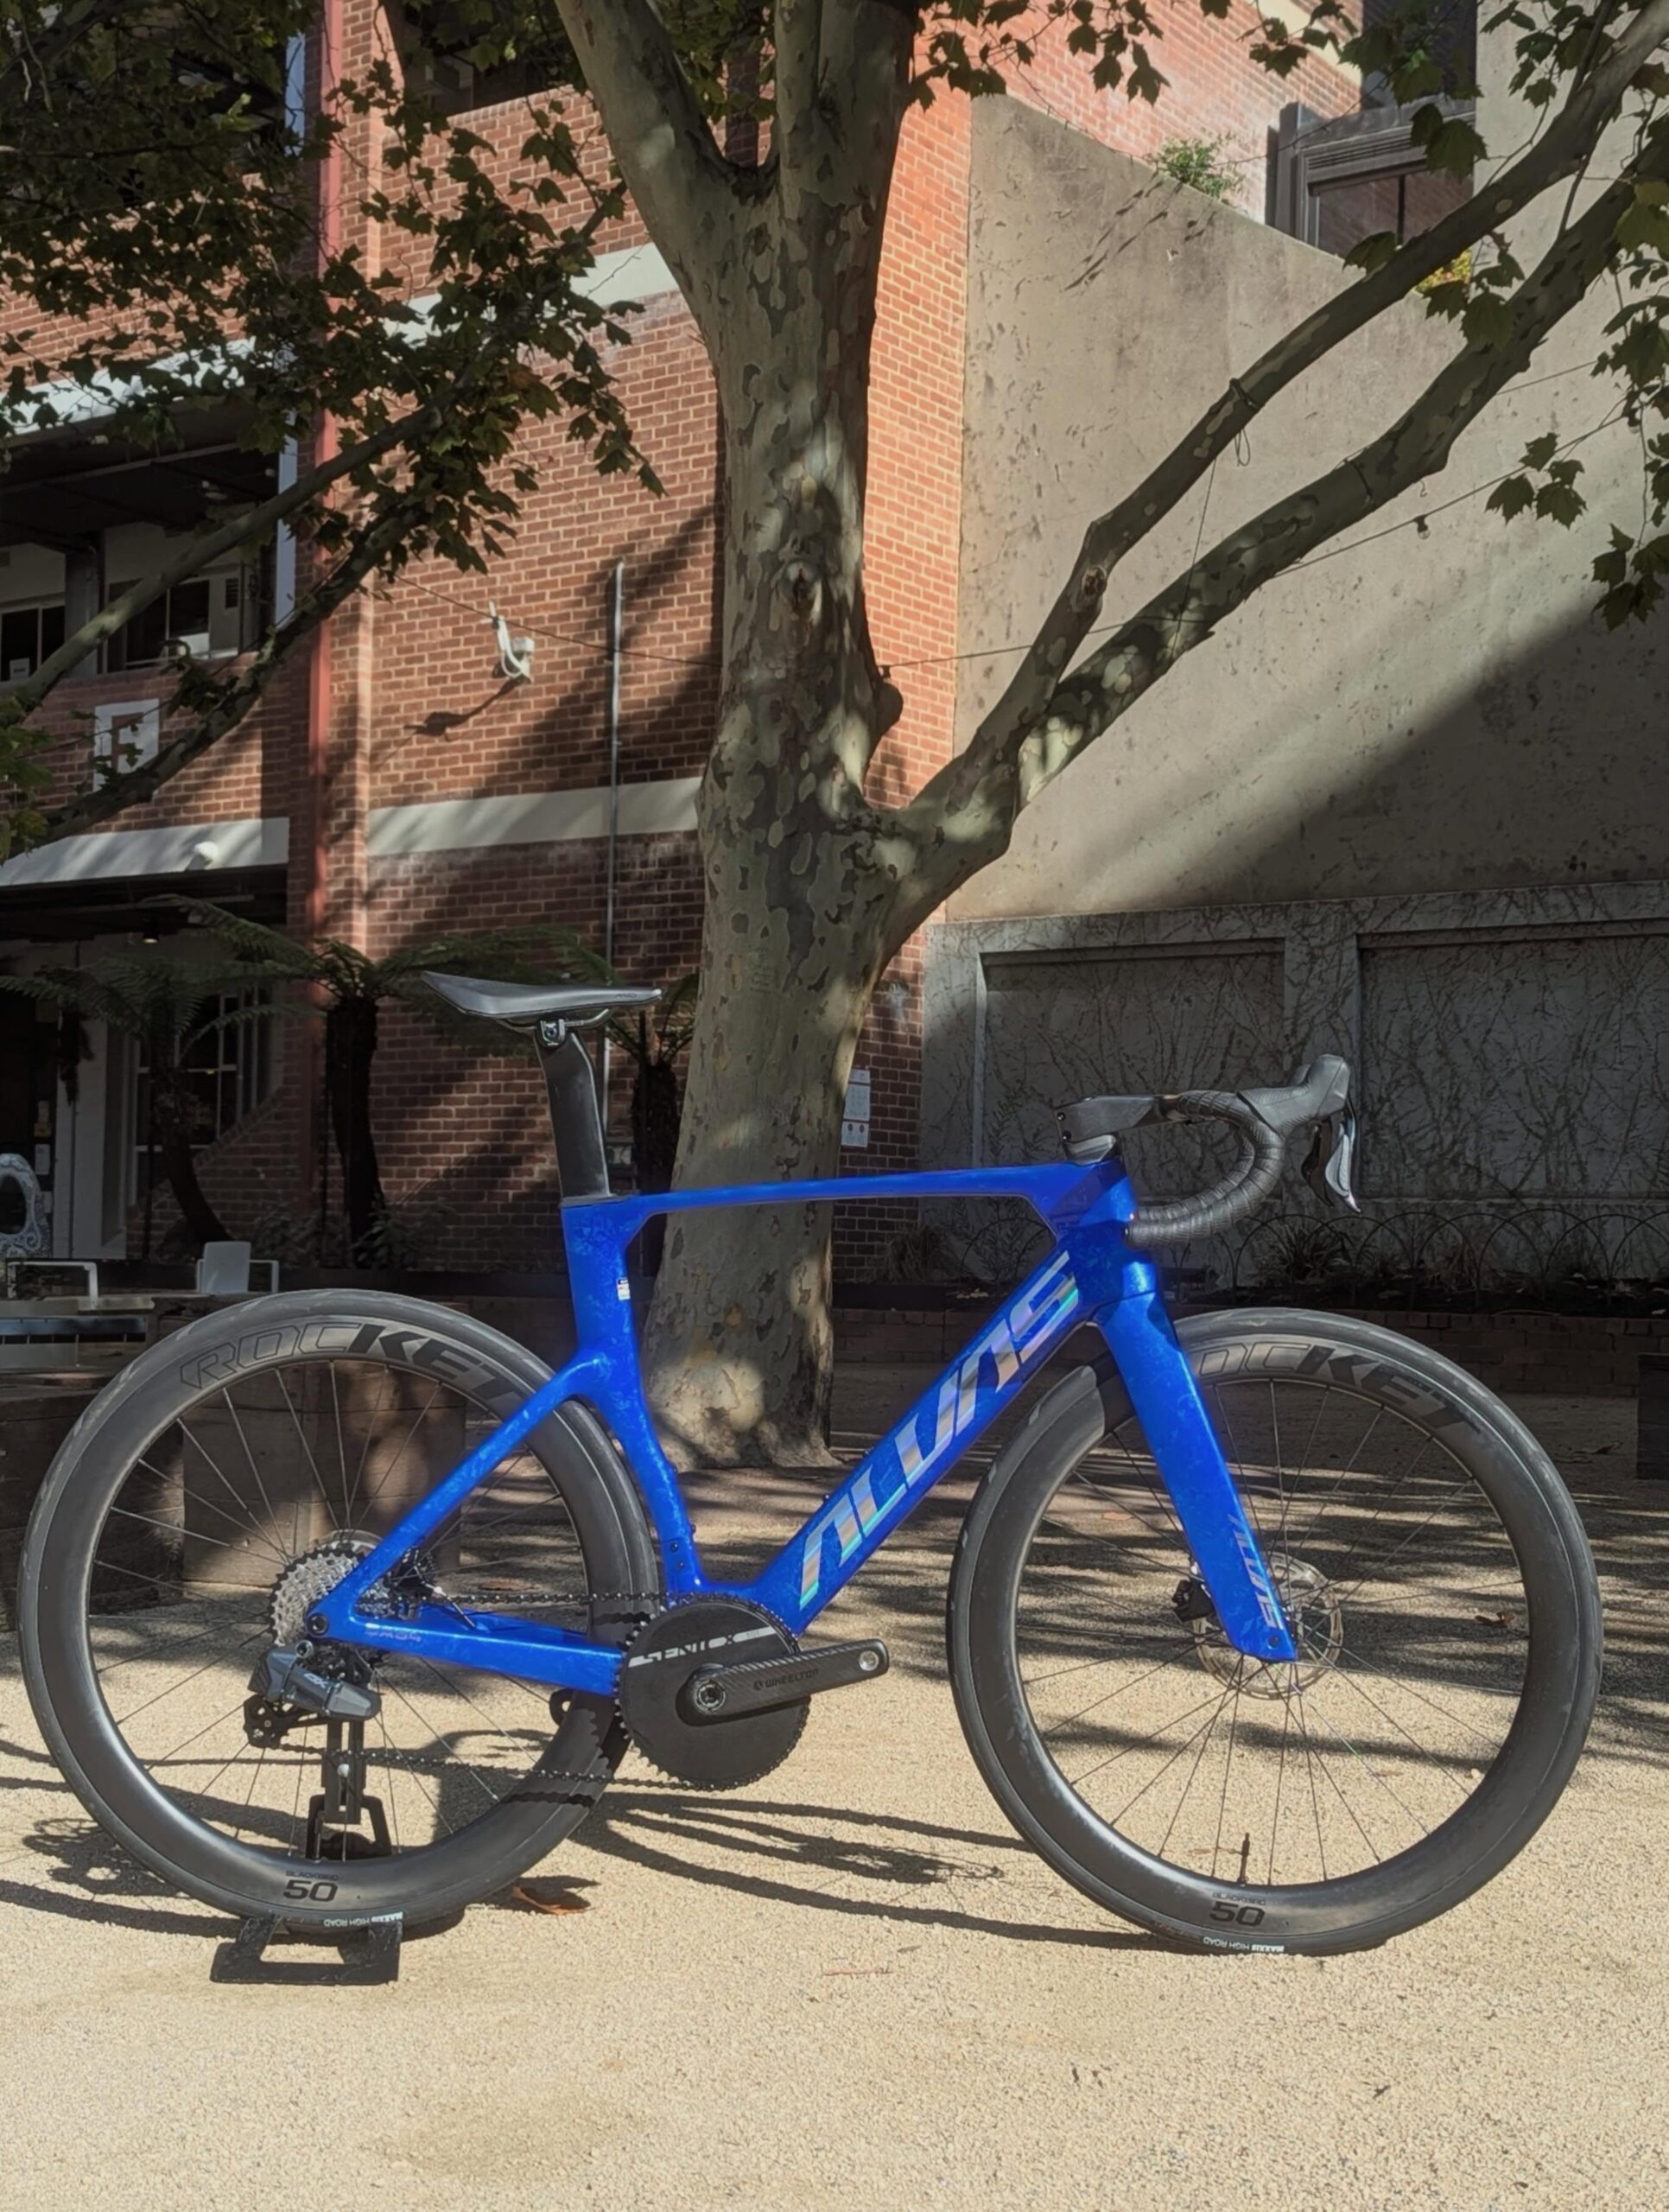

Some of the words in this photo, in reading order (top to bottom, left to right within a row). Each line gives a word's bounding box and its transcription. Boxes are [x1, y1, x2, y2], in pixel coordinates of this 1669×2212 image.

[180, 1320, 526, 1405] ROCKET
[1190, 1340, 1482, 1435] OCKET
[765, 1669, 819, 1688] WHEELTOP
[283, 1879, 338, 1902] 50
[323, 1918, 348, 1928] ROAD
[349, 1917, 371, 1927] HIGH
[1209, 1901, 1266, 1926] 50
[1203, 1936, 1228, 1948] ROAD
[1228, 1942, 1250, 1951] HIGH
